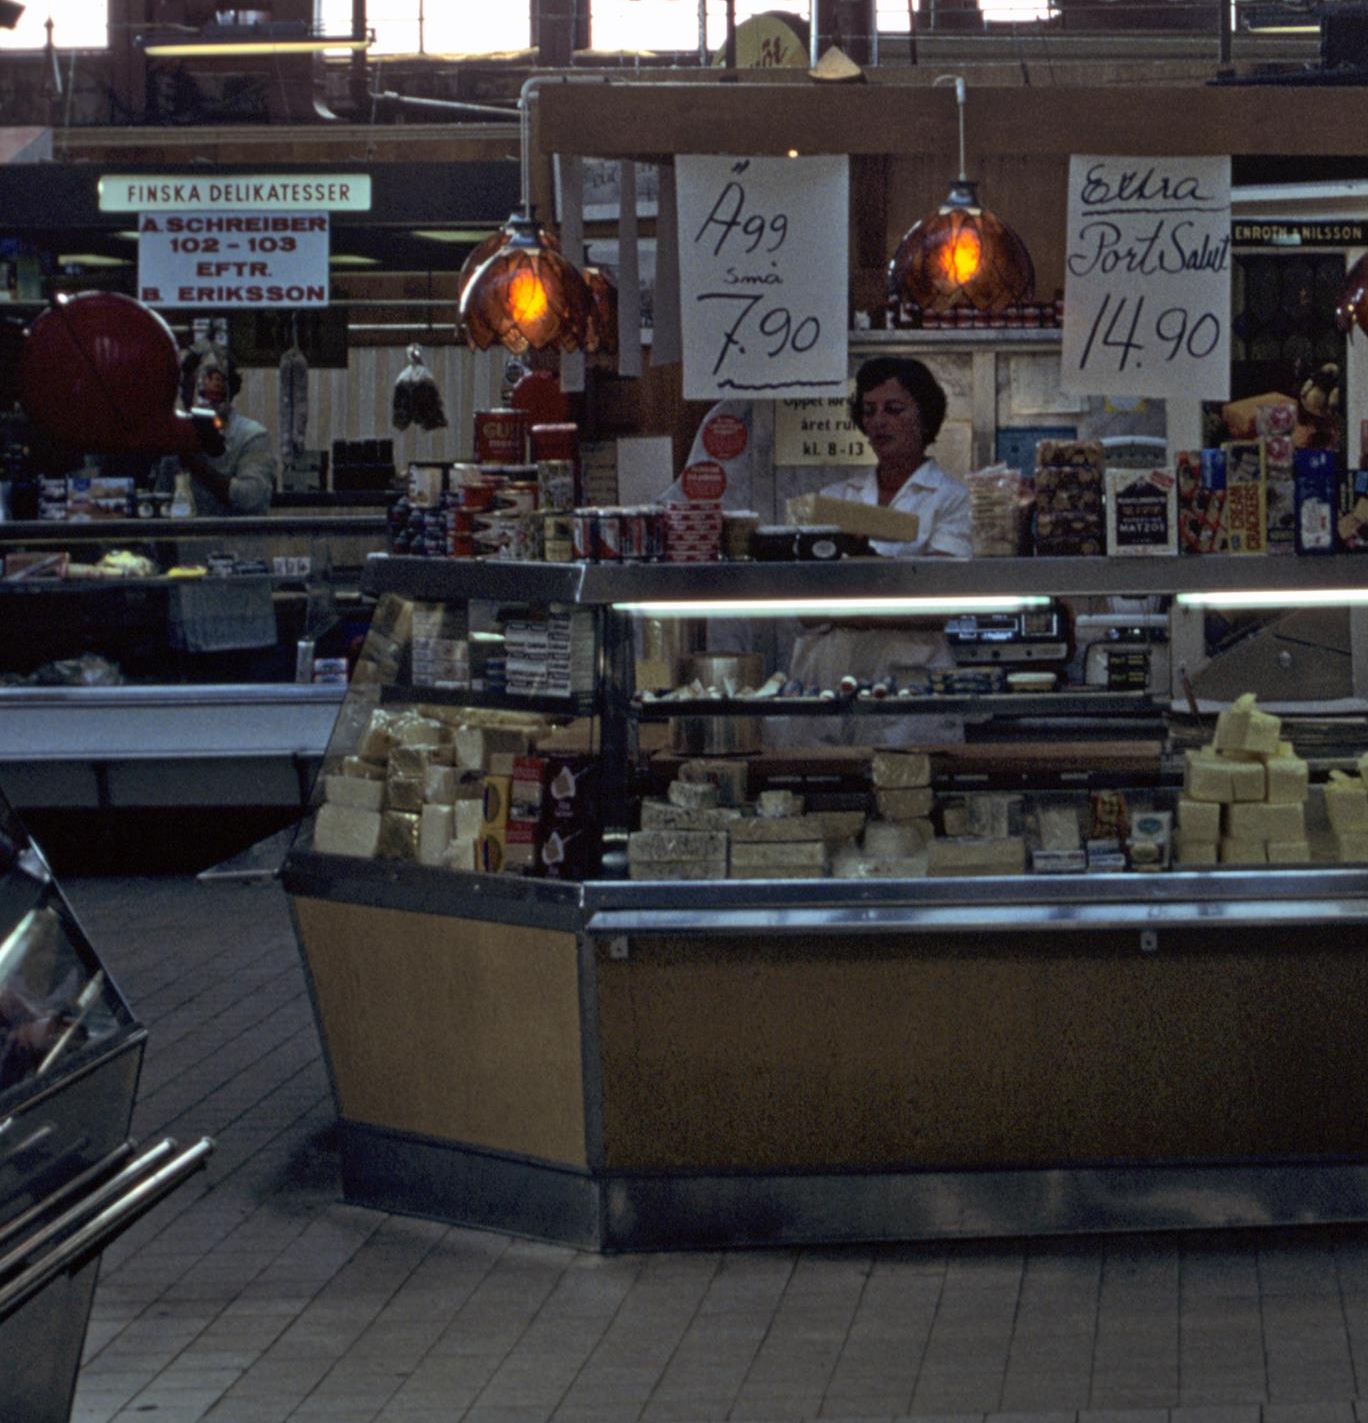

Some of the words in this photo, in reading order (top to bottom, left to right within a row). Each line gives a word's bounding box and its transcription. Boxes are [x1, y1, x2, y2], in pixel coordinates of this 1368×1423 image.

[127, 184, 201, 203] FINSKA
[209, 183, 351, 202] DELIKATESSER
[1081, 163, 1215, 205] Extra
[694, 159, 788, 257] Ägg
[1234, 225, 1288, 241] ENROTH
[1301, 226, 1362, 241] NILSSON
[169, 237, 220, 254] 102
[249, 236, 297, 254] 103
[1068, 219, 1160, 278] Port
[1159, 220, 1231, 274] Salut
[196, 261, 273, 278] EFTR.
[723, 260, 783, 285] små
[141, 286, 164, 303] B.
[177, 285, 326, 303] ERIKSSON
[697, 292, 821, 375] 7.90
[1080, 293, 1221, 371] 14.90
[801, 418, 831, 431] året
[803, 441, 821, 456] kl.
